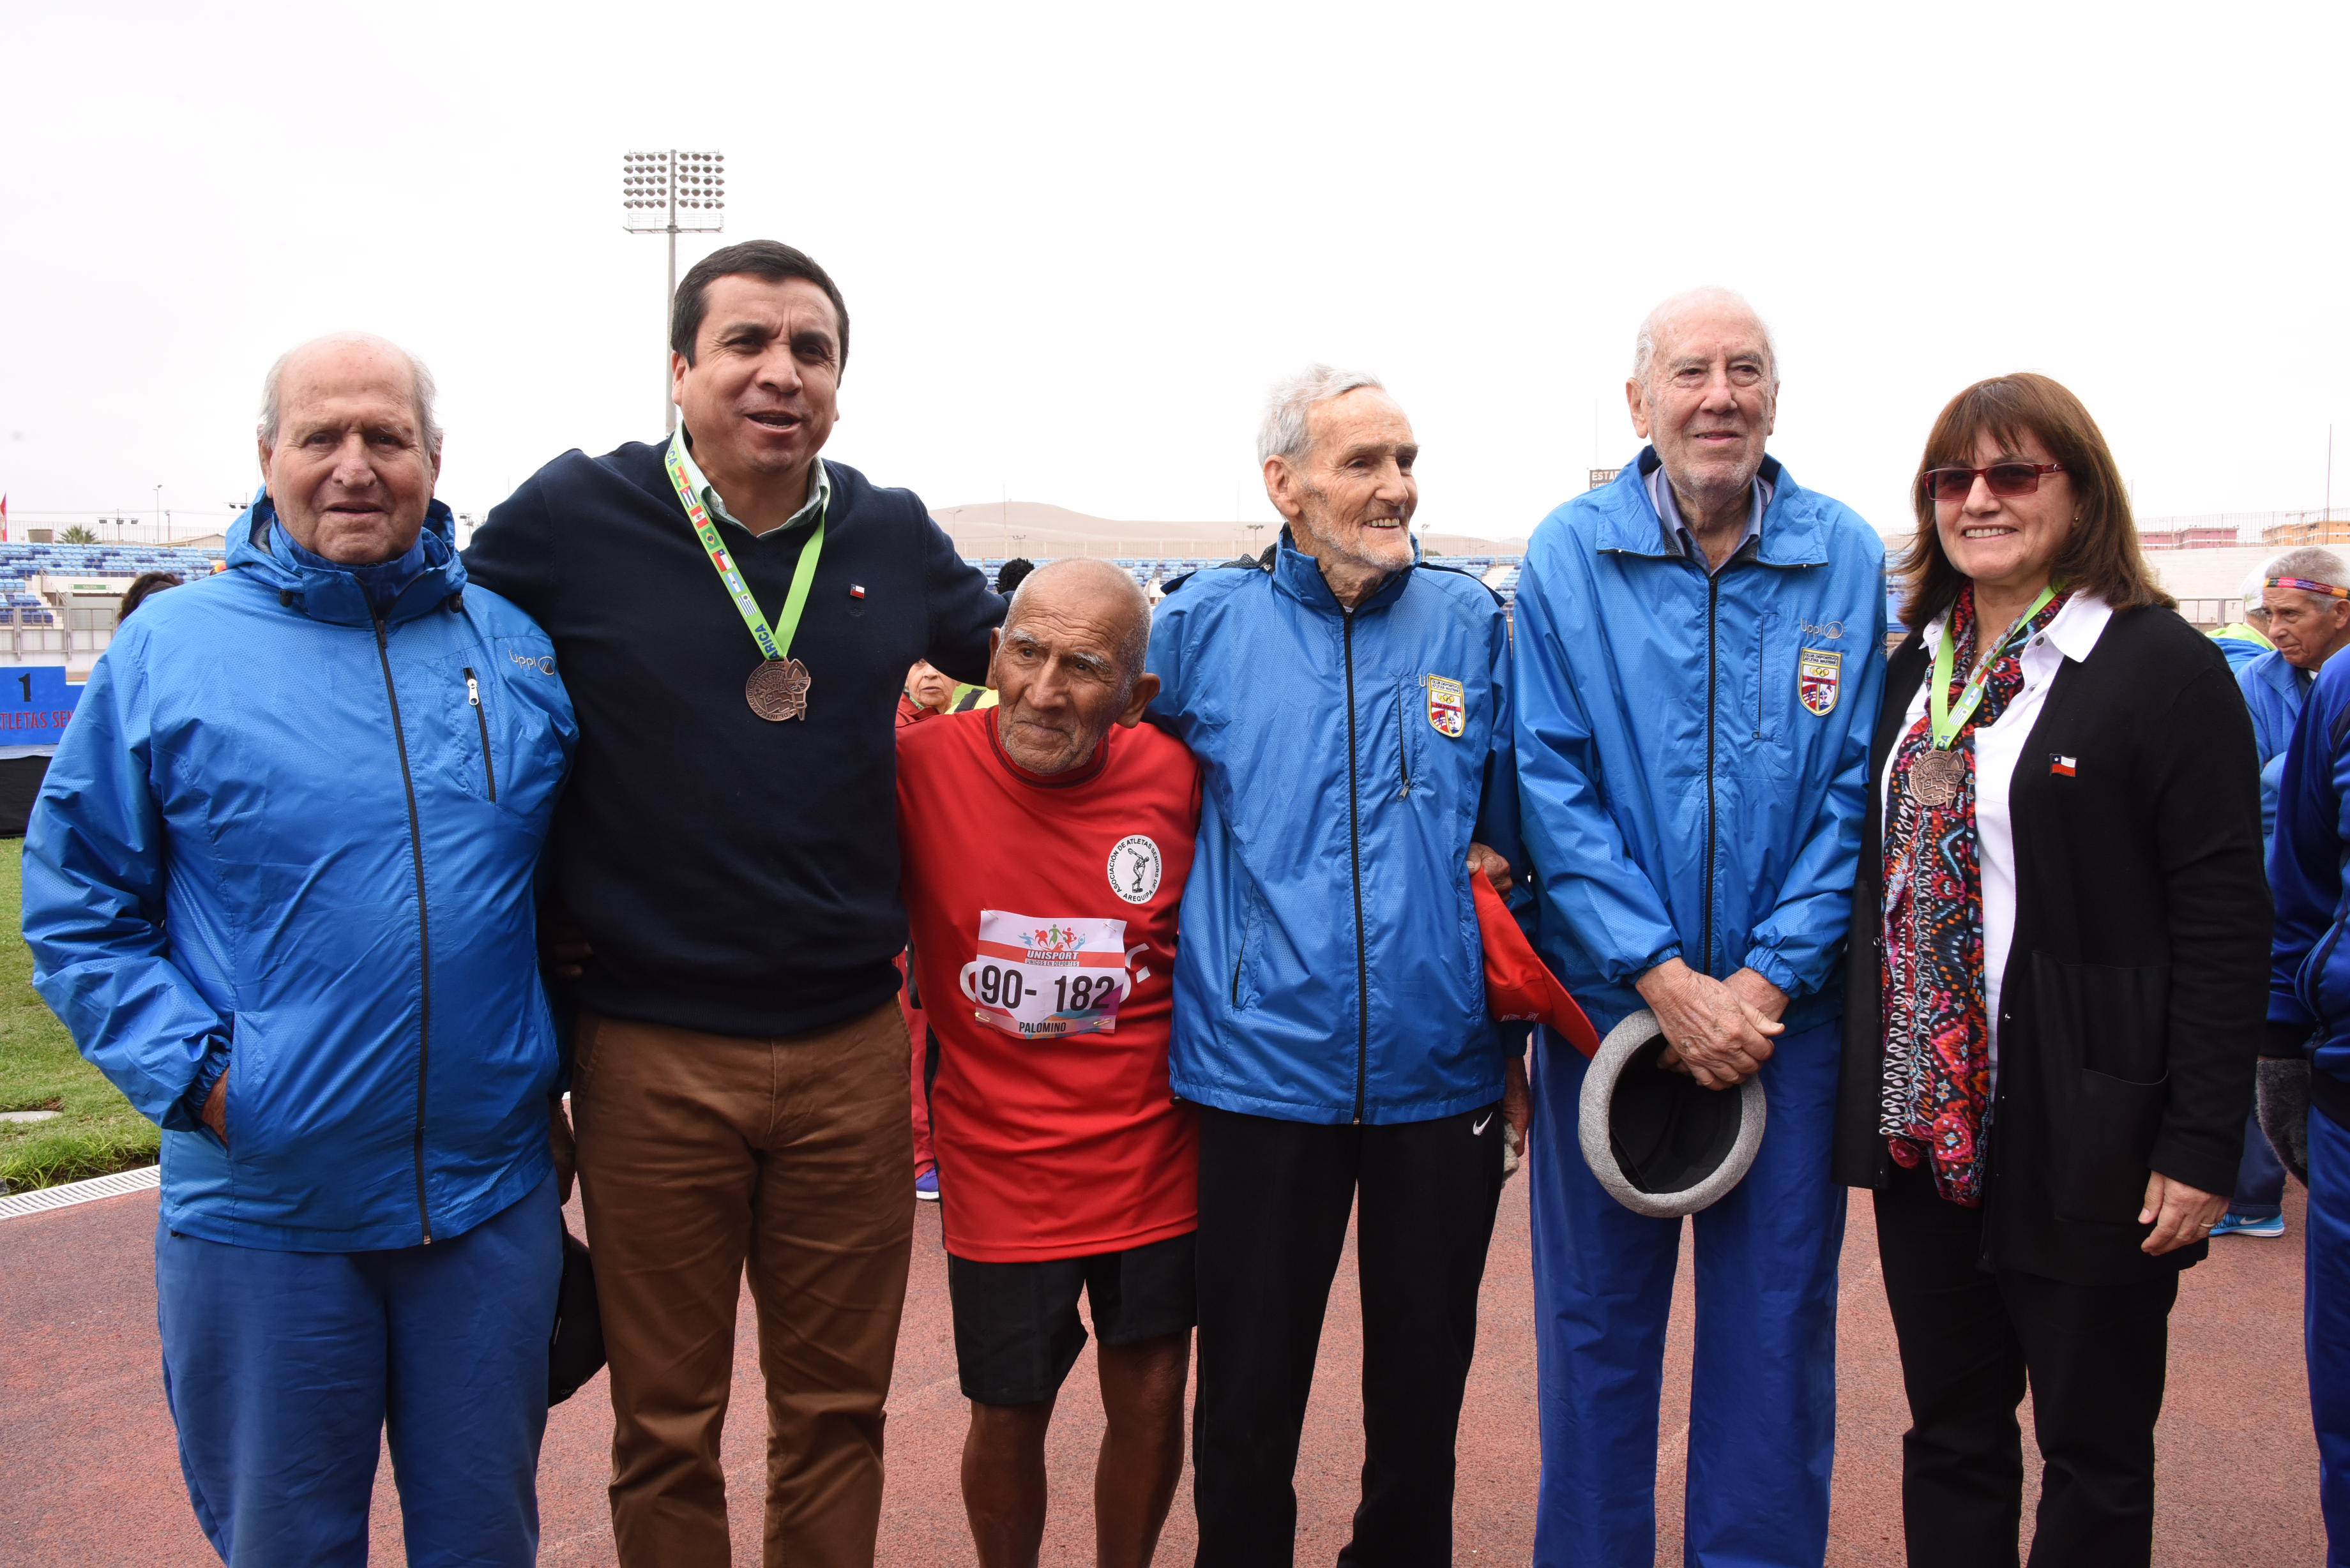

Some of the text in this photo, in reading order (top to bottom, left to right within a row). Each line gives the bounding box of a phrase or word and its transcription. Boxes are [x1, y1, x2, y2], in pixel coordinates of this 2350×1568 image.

[755, 623, 780, 660] ARICA
[17, 672, 31, 702] 1
[0, 712, 48, 730] TLETAS
[1118, 842, 1126, 852] DE
[1126, 838, 1152, 849] ATLETAS
[1151, 848, 1159, 878] SENIORS
[1152, 879, 1157, 889] DE
[1123, 890, 1153, 901] AREQUIPA
[1027, 950, 1079, 960] UNISPORT
[1054, 975, 1115, 1012] 182
[1019, 1021, 1066, 1033] PALOMINO
